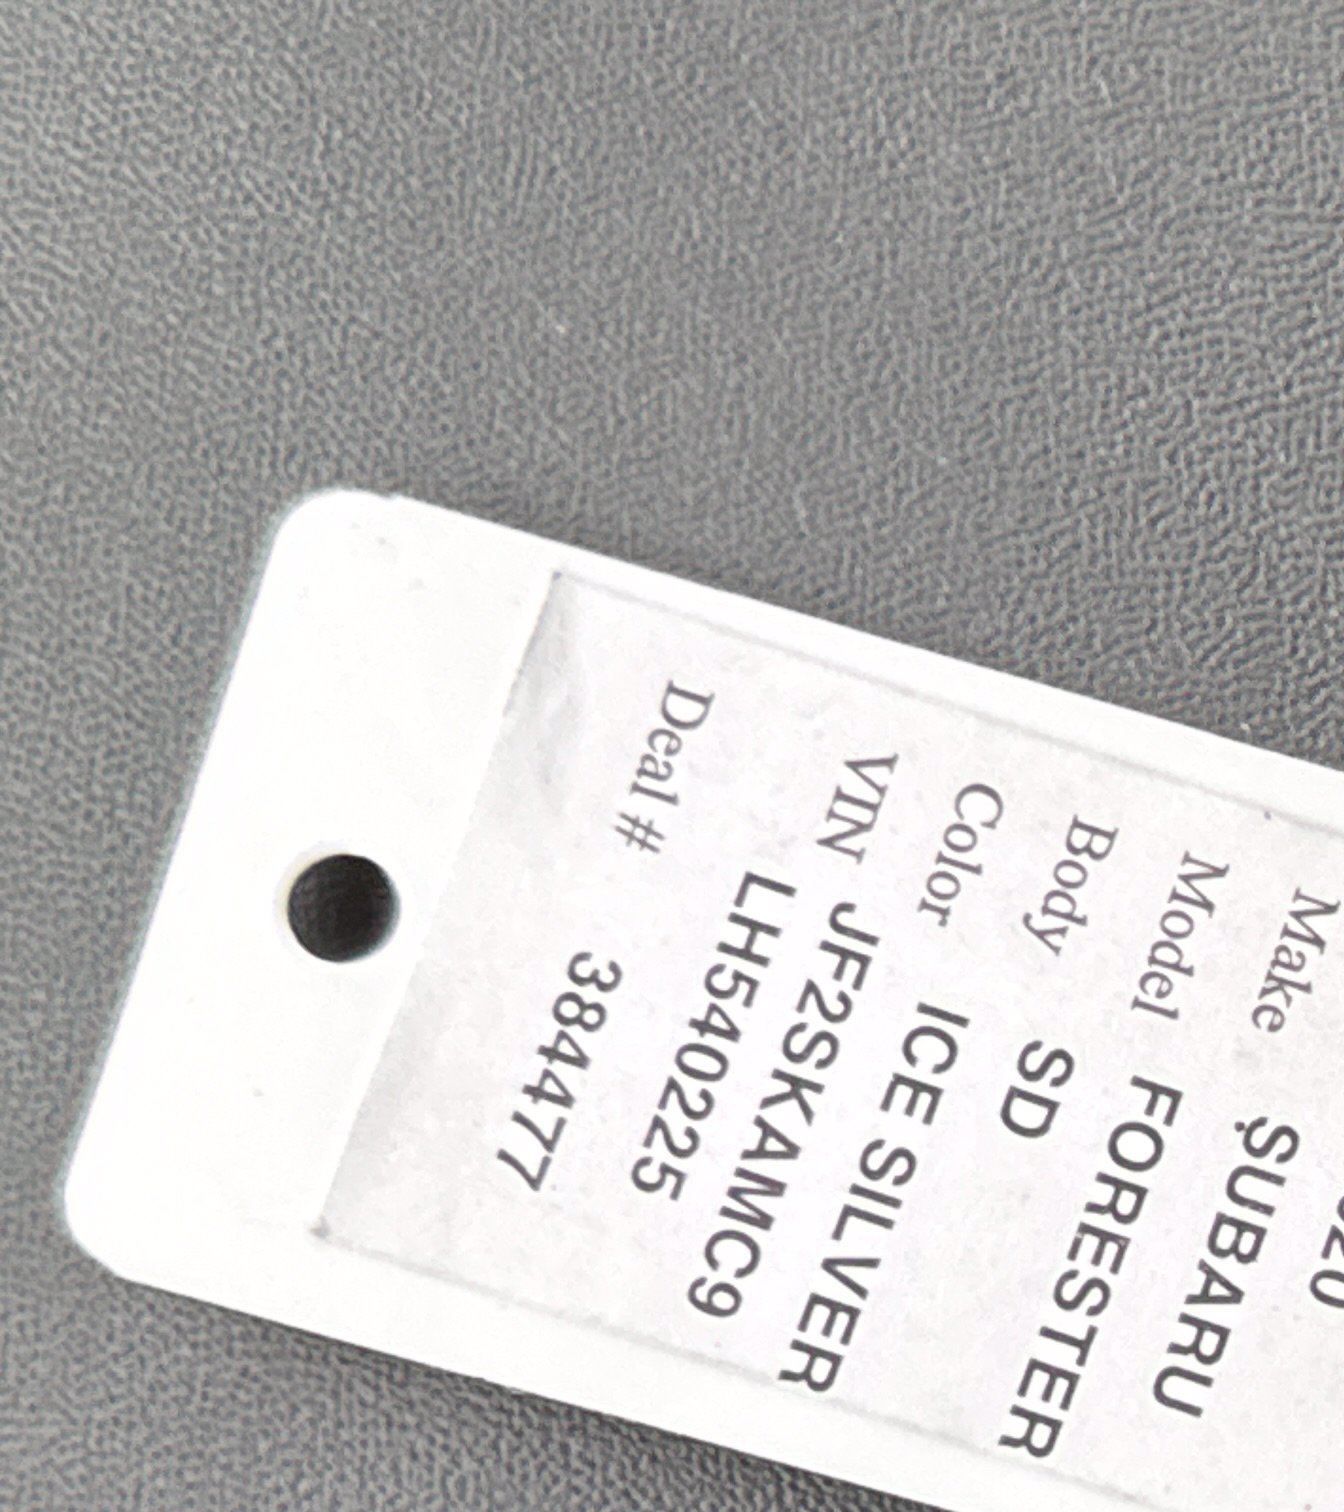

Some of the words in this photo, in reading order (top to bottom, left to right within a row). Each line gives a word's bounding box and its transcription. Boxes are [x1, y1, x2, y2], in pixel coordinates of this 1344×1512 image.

[630, 679, 715, 805] Deal
[816, 753, 898, 863] VIN
[614, 811, 666, 854] #
[917, 782, 1003, 927] Color
[1023, 814, 1119, 957] Body
[1131, 851, 1230, 1019] Model
[1252, 886, 1341, 1033] Make
[497, 952, 623, 1192] 384477
[631, 870, 796, 1200] LH540225
[880, 1001, 970, 1124] ICE
[1000, 1040, 1075, 1138] SD
[687, 902, 880, 1318] JF2SKAMC9
[778, 1138, 918, 1393] SILVER
[998, 1075, 1183, 1459] FORESTER
[1152, 1115, 1300, 1418] SUBARU
